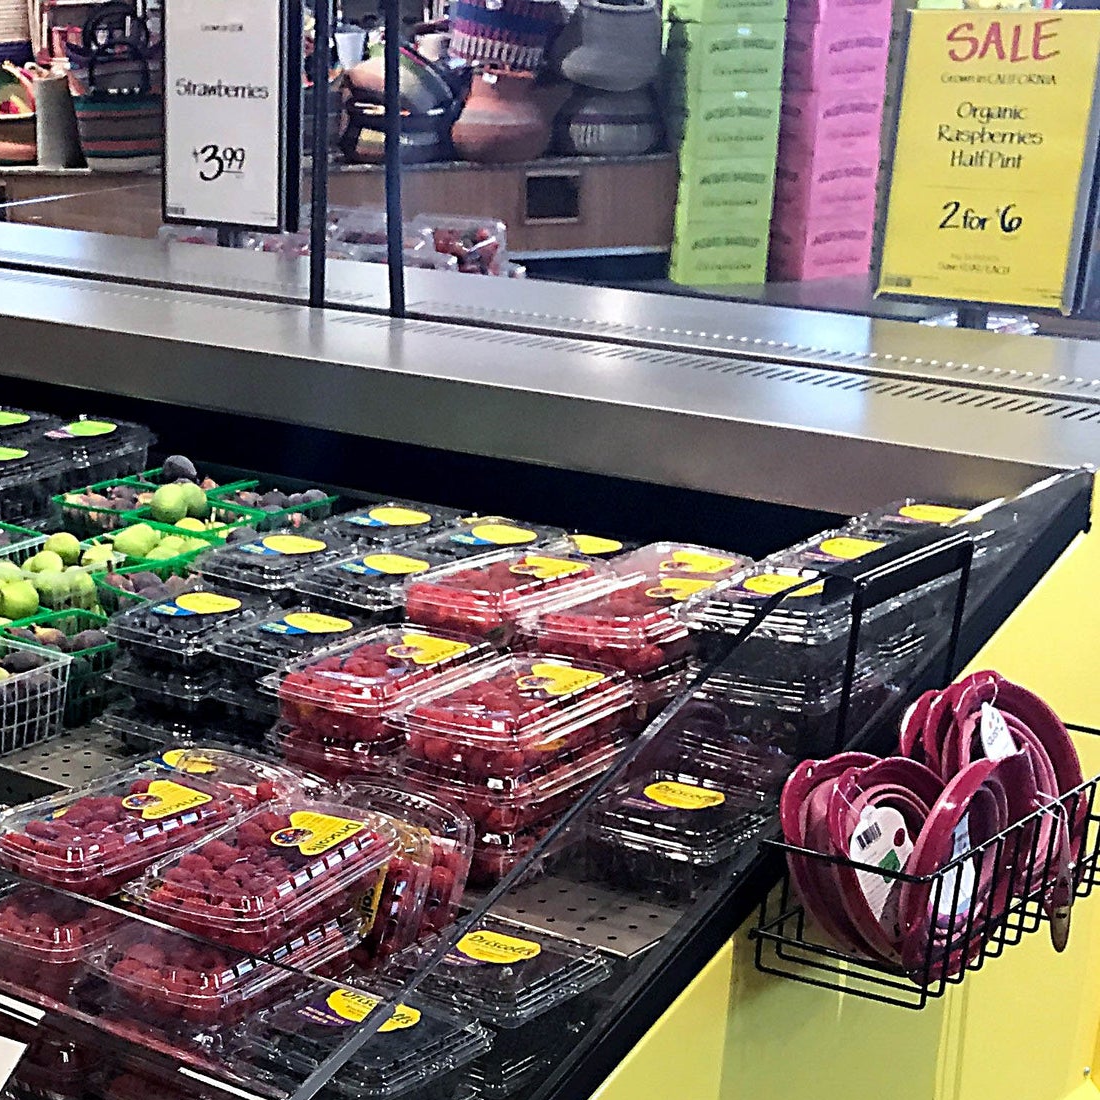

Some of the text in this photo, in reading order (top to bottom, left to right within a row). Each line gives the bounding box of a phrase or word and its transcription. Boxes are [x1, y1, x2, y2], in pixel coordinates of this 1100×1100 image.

[947, 17, 1063, 63] SALE
[175, 78, 270, 100] Strawberries
[956, 101, 1028, 124] Organic
[937, 124, 1044, 145] Raspberries
[950, 149, 1023, 169] Half Pint
[938, 201, 960, 230] 2
[962, 208, 991, 231] for
